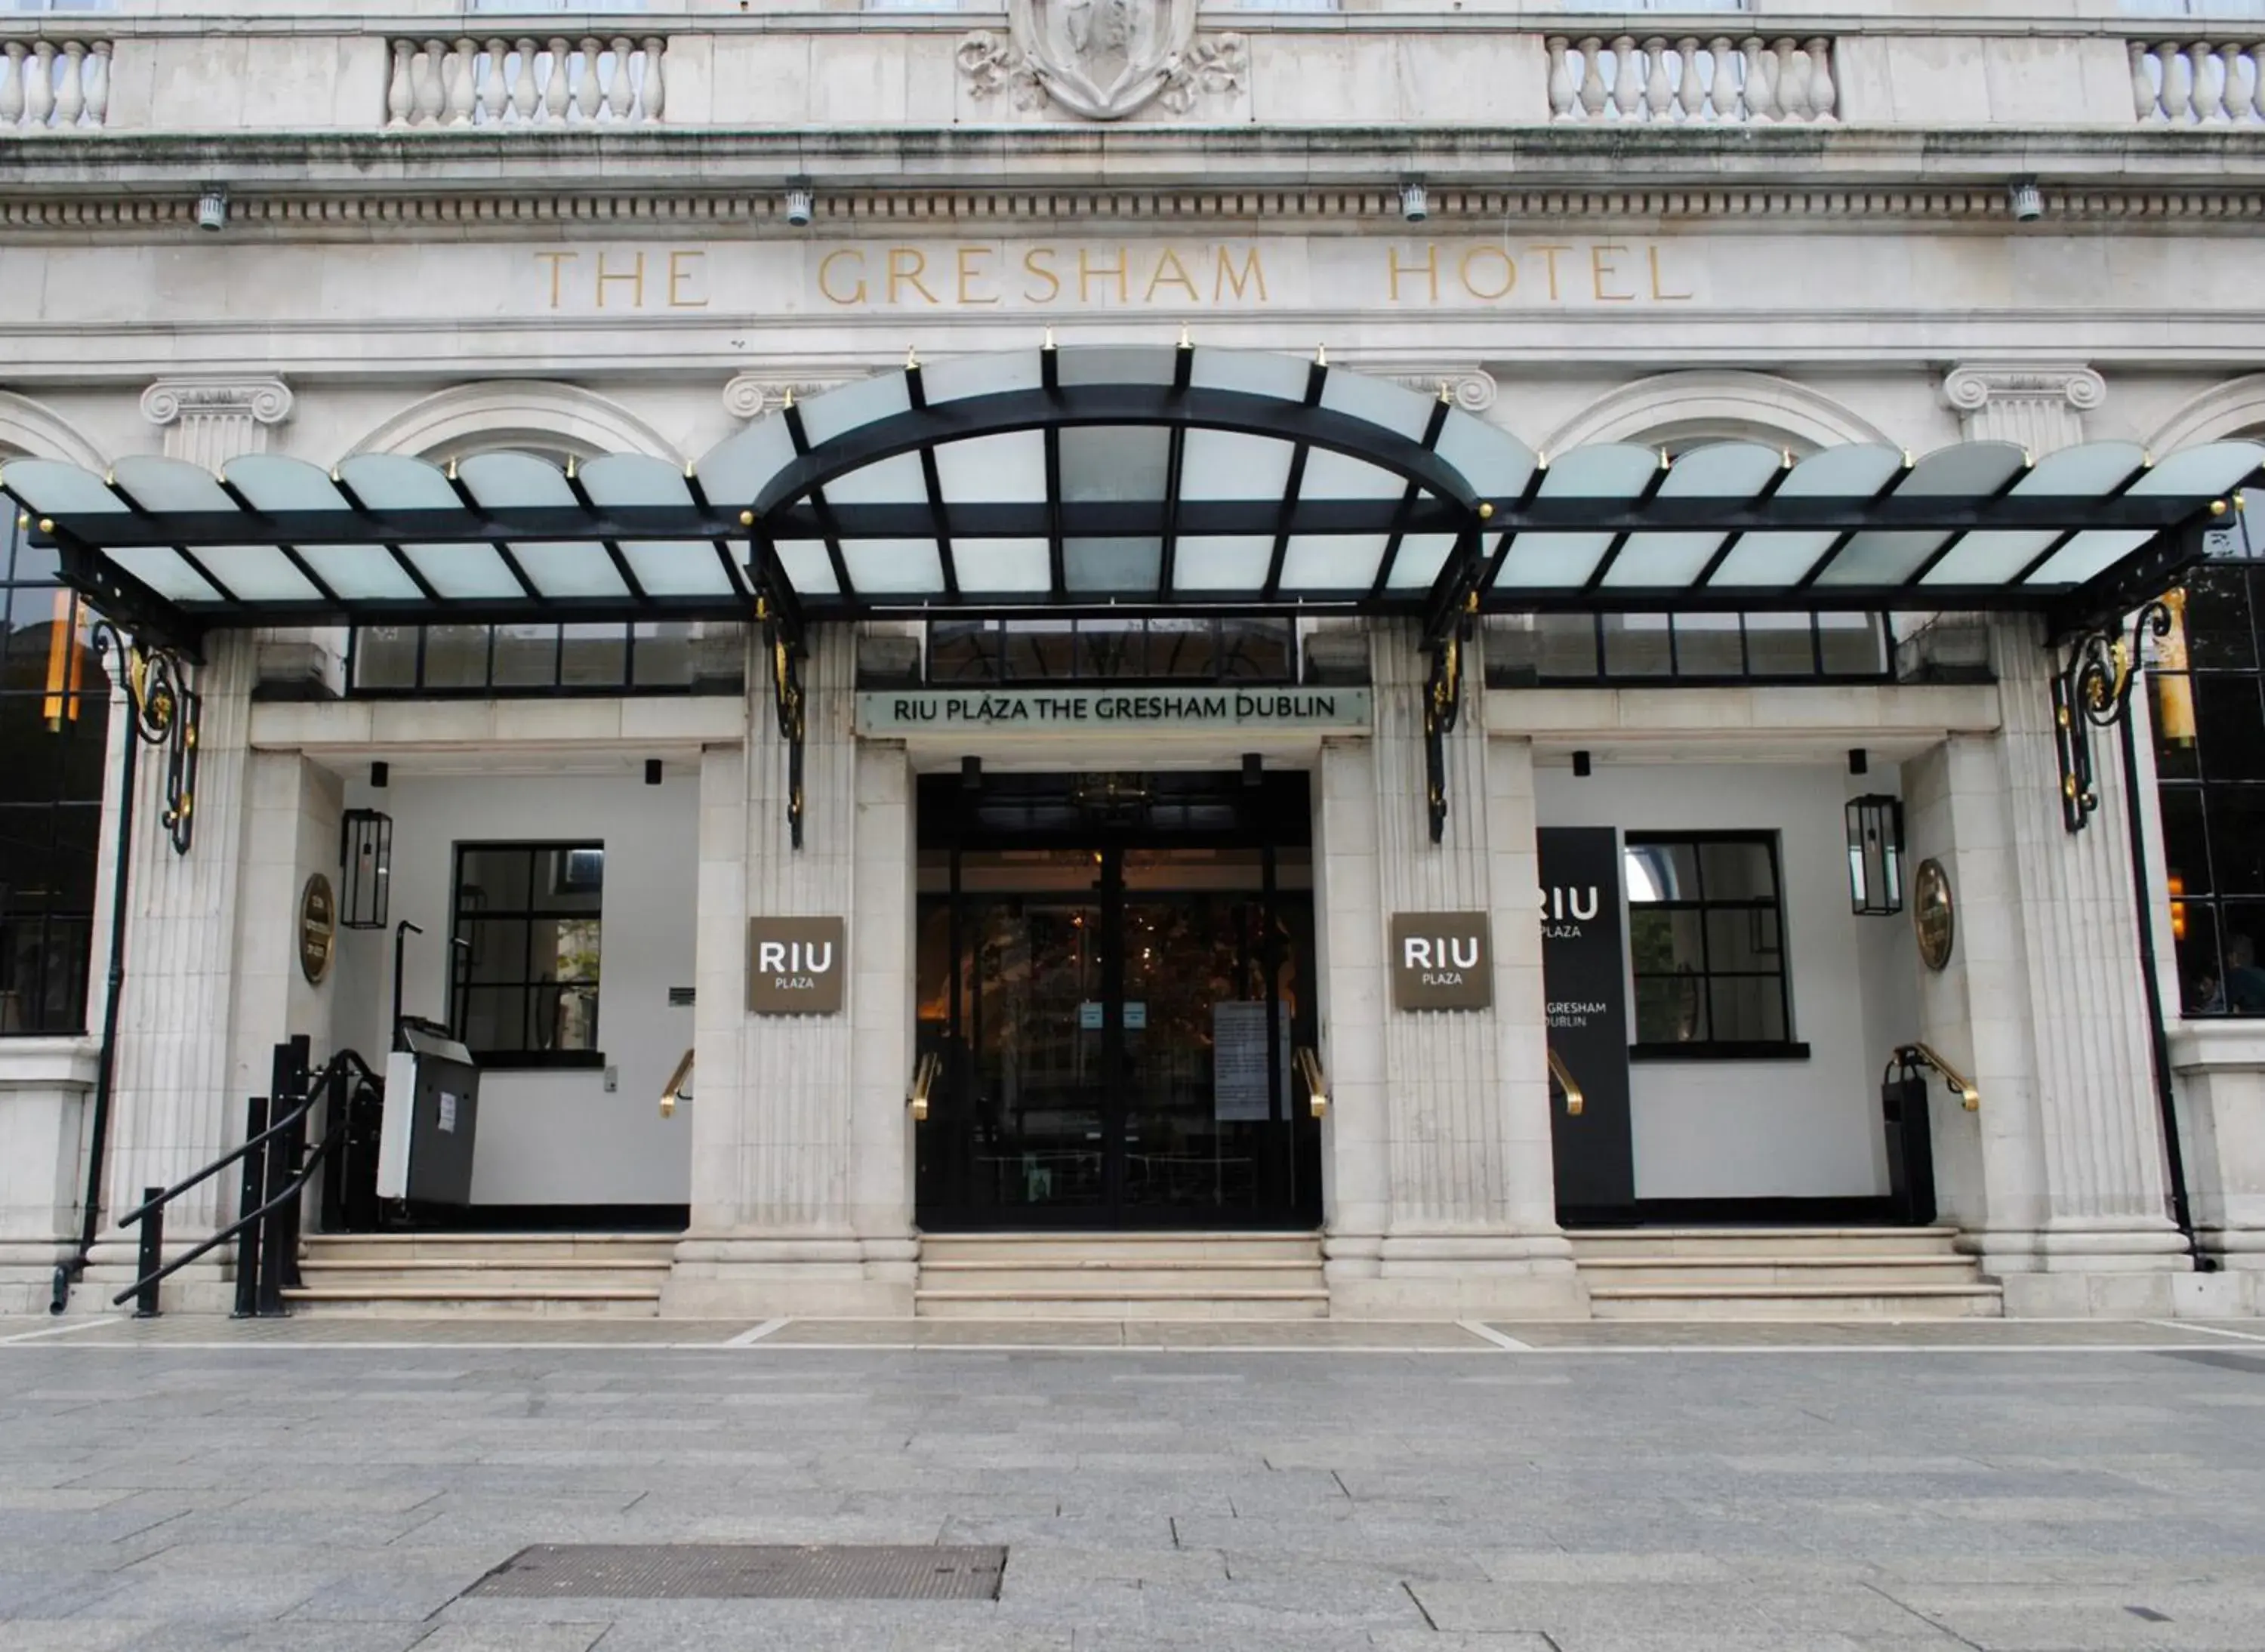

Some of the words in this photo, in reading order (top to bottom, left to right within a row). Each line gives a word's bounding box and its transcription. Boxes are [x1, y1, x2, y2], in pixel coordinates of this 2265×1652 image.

[533, 251, 709, 308] THE
[818, 246, 1268, 304] GRESHAM
[1387, 243, 1693, 301] HOTEL
[894, 699, 937, 721] RIU
[946, 698, 1029, 720] PLAZA
[1033, 698, 1088, 720] THE
[1095, 696, 1226, 719] GRESHAM
[1235, 695, 1335, 717] DUBLIN
[760, 942, 831, 972] RIU
[1404, 937, 1478, 968] RIU
[775, 978, 815, 989] PLAZA
[1422, 972, 1462, 985] PLAZA
[1547, 1002, 1607, 1014] GRESHAM
